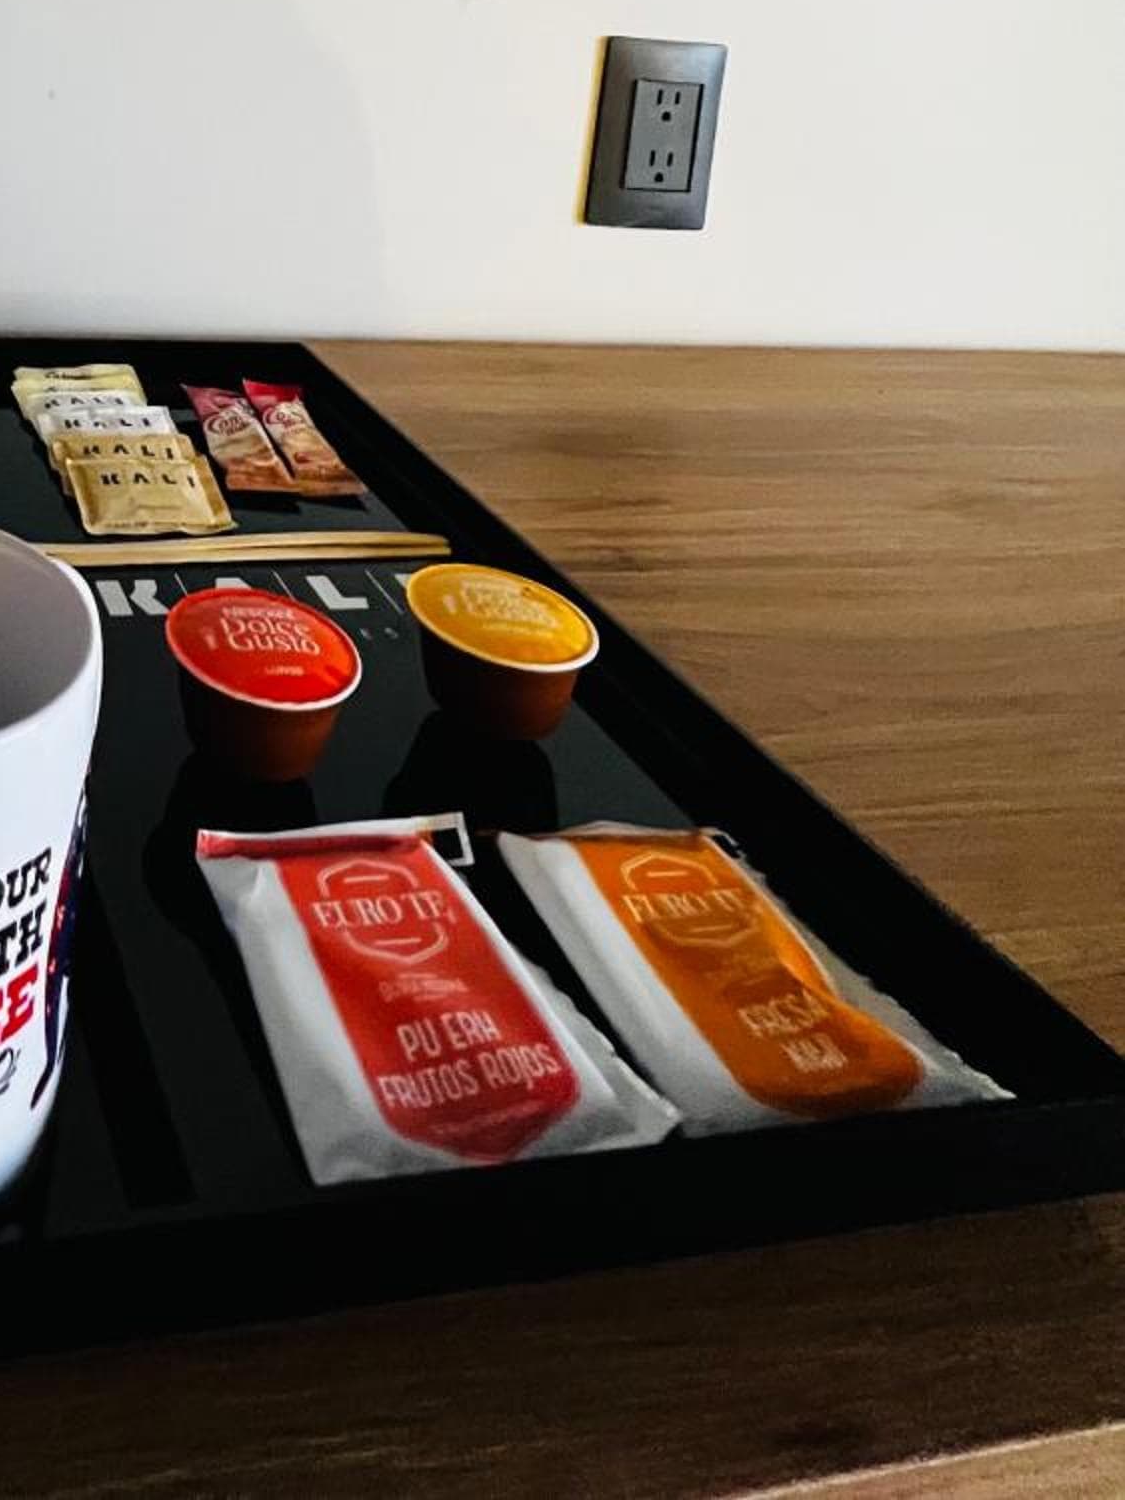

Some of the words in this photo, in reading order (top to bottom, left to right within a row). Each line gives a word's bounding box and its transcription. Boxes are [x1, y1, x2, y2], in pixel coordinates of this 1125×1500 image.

[83, 443, 174, 460] KALI
[100, 472, 195, 489] KALI
[396, 1019, 441, 1062] PU
[440, 1011, 502, 1050] ERH
[377, 1058, 480, 1109] FRUTOS
[478, 1042, 562, 1091] ROJOS
